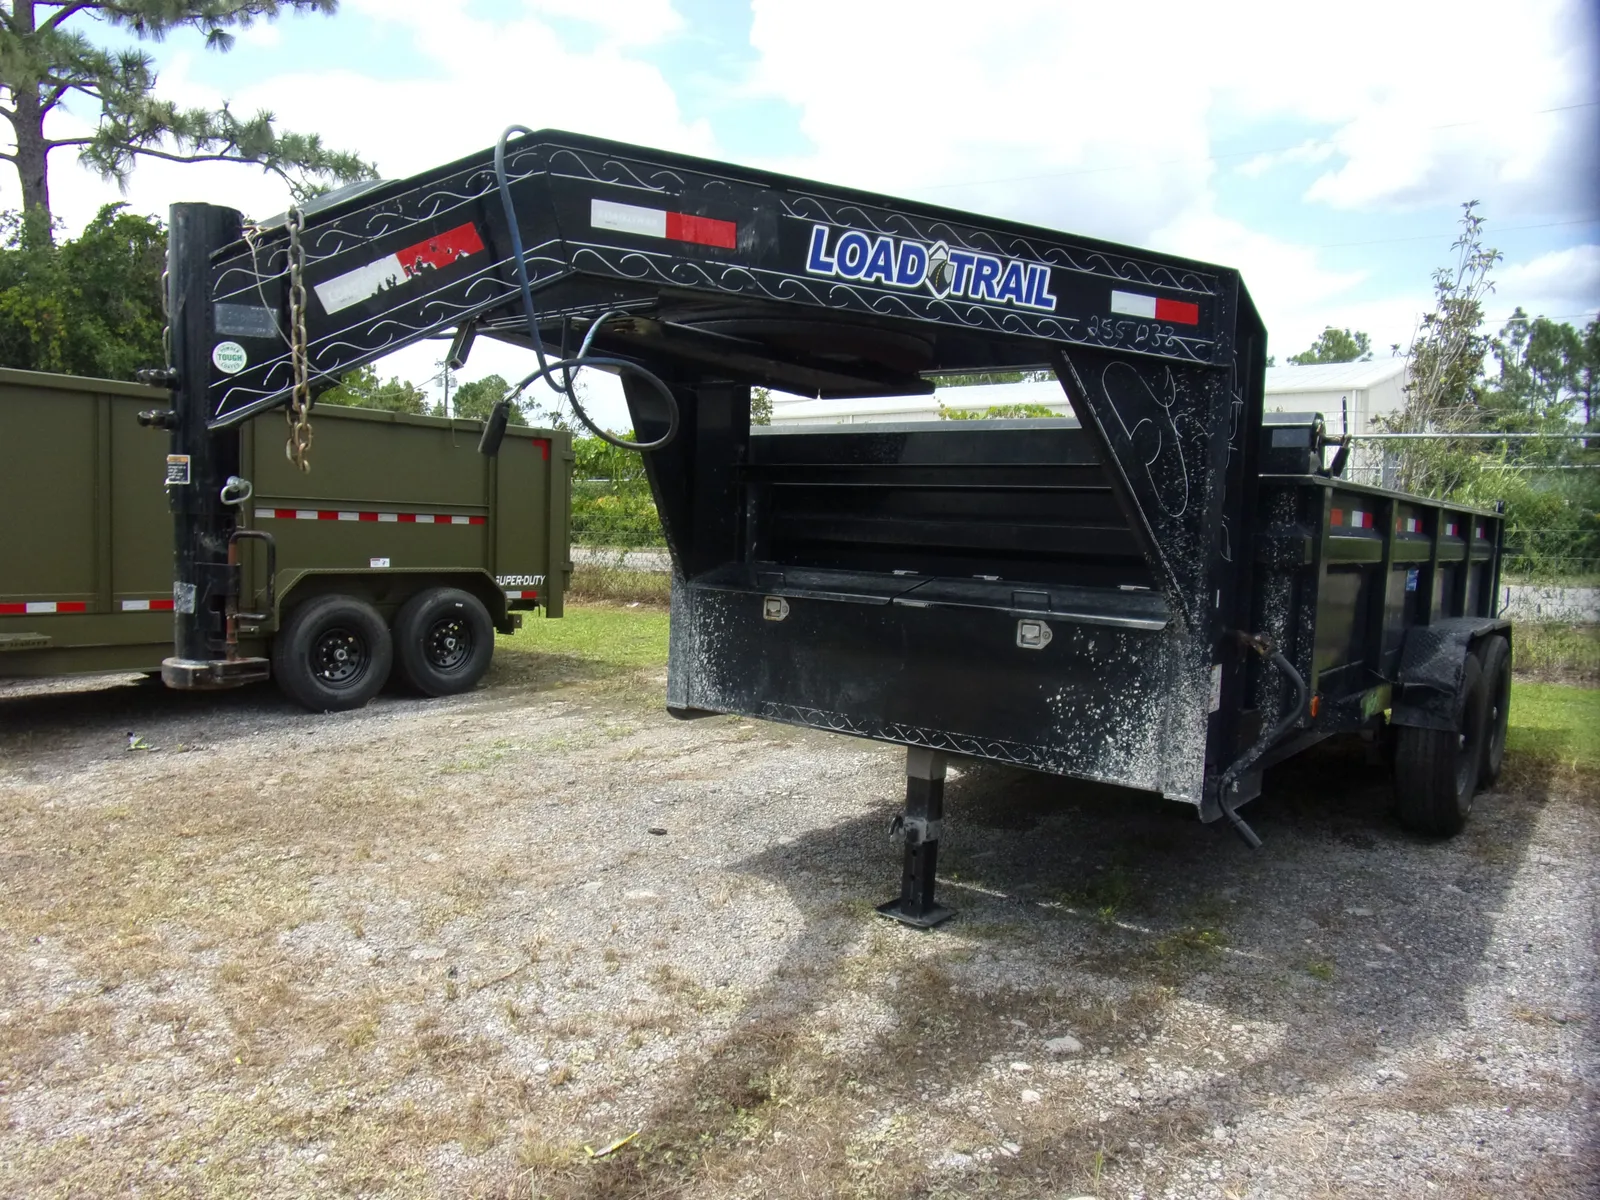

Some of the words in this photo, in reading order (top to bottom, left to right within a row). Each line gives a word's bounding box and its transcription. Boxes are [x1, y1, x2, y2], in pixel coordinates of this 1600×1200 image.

[806, 224, 929, 288] LOAD
[947, 249, 1057, 311] TRAIL
[217, 353, 243, 362] TOUGH
